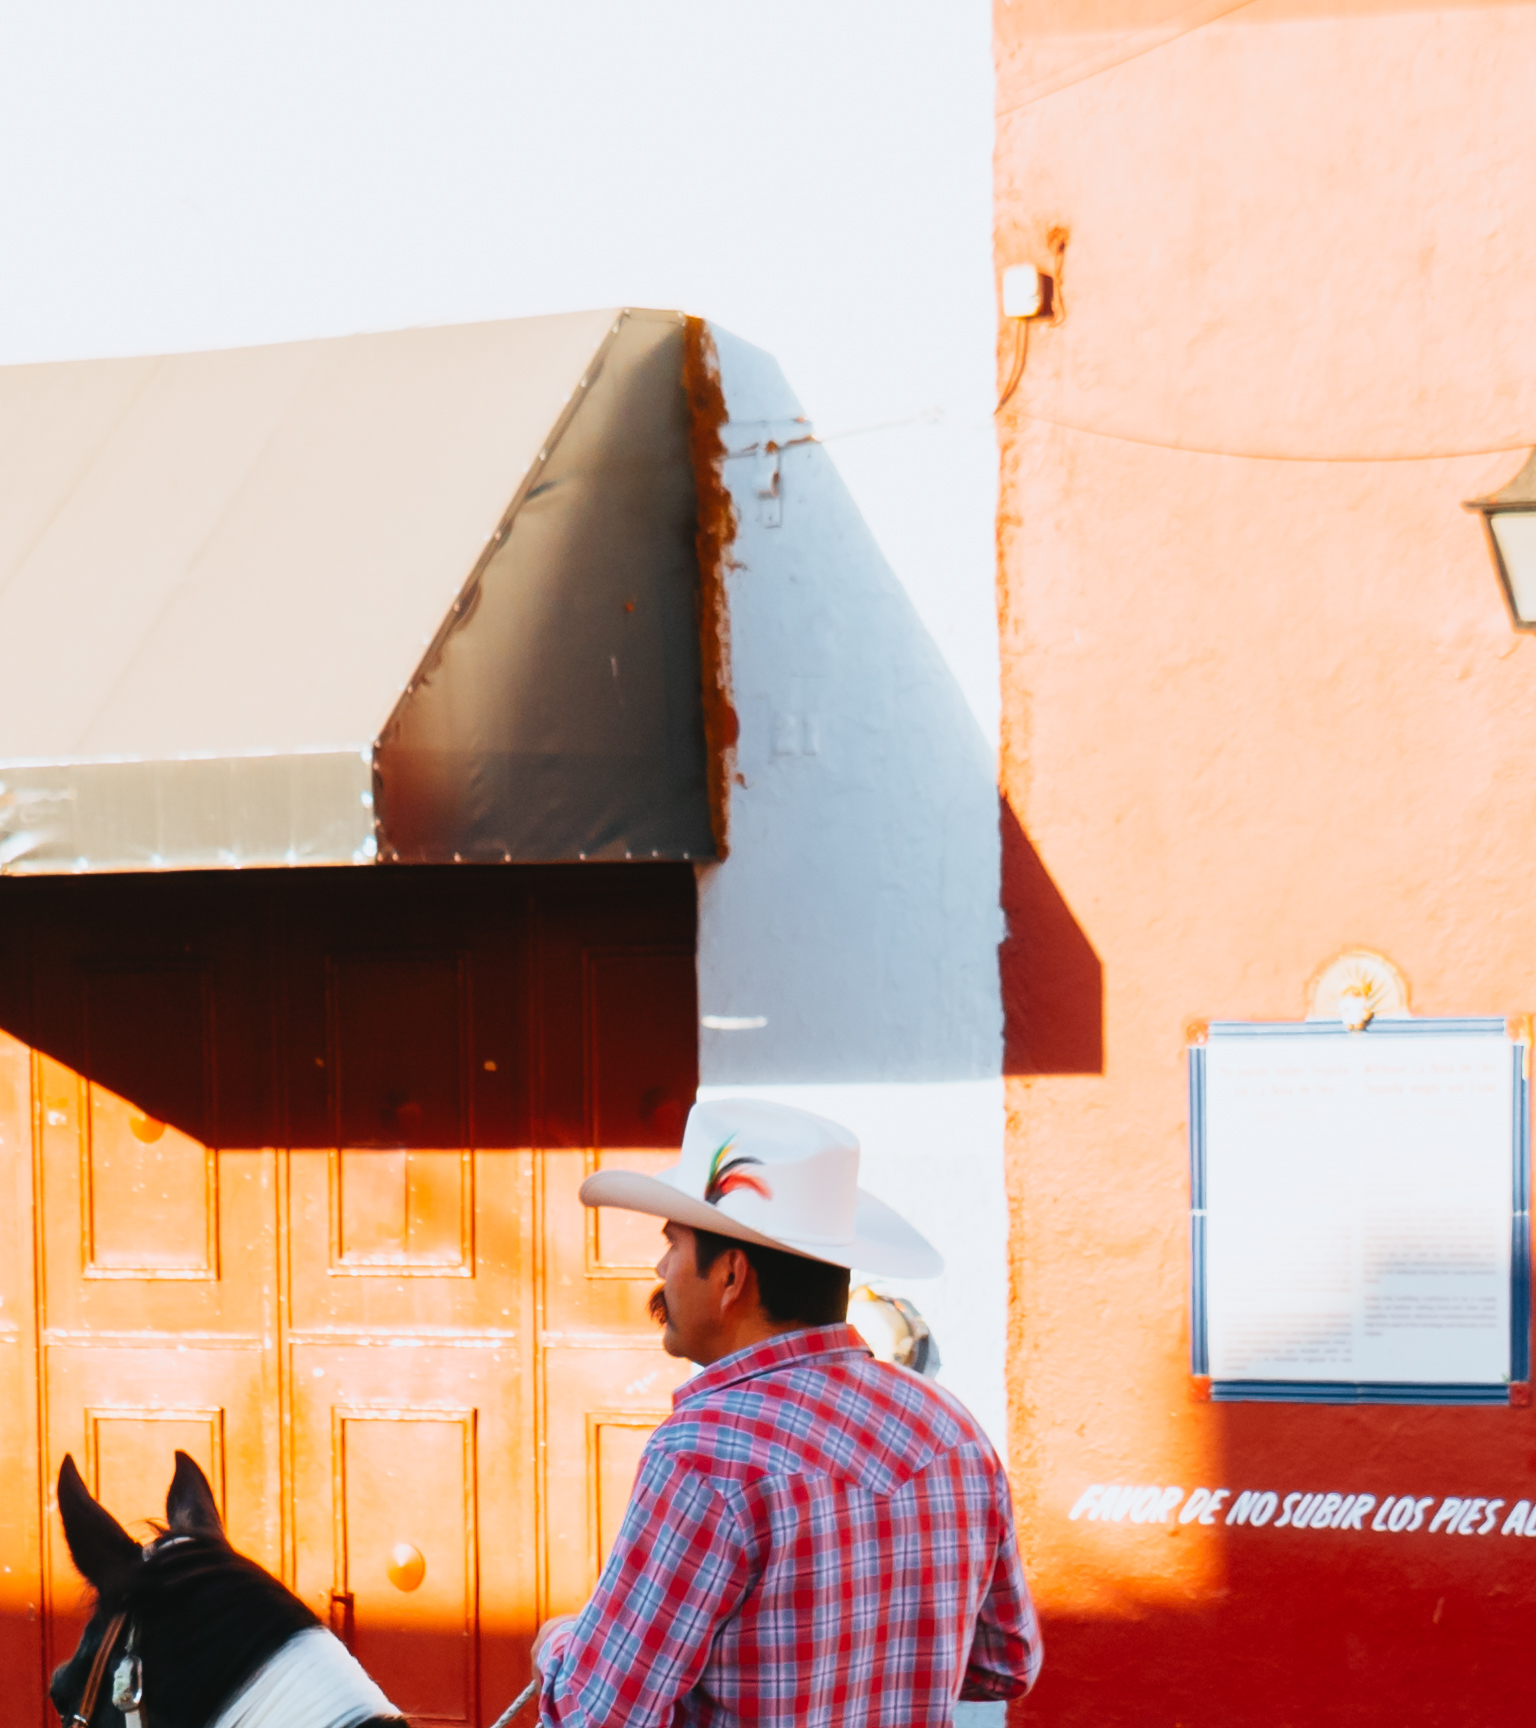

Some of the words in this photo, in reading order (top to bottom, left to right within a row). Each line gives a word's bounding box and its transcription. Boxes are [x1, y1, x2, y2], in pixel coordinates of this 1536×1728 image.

[1068, 1484, 1184, 1524] FAVOR
[1178, 1487, 1231, 1525] DE
[1225, 1489, 1279, 1528] NO
[1273, 1491, 1376, 1531] SUBIR
[1371, 1494, 1434, 1533] LOS
[1428, 1496, 1506, 1536] PIES
